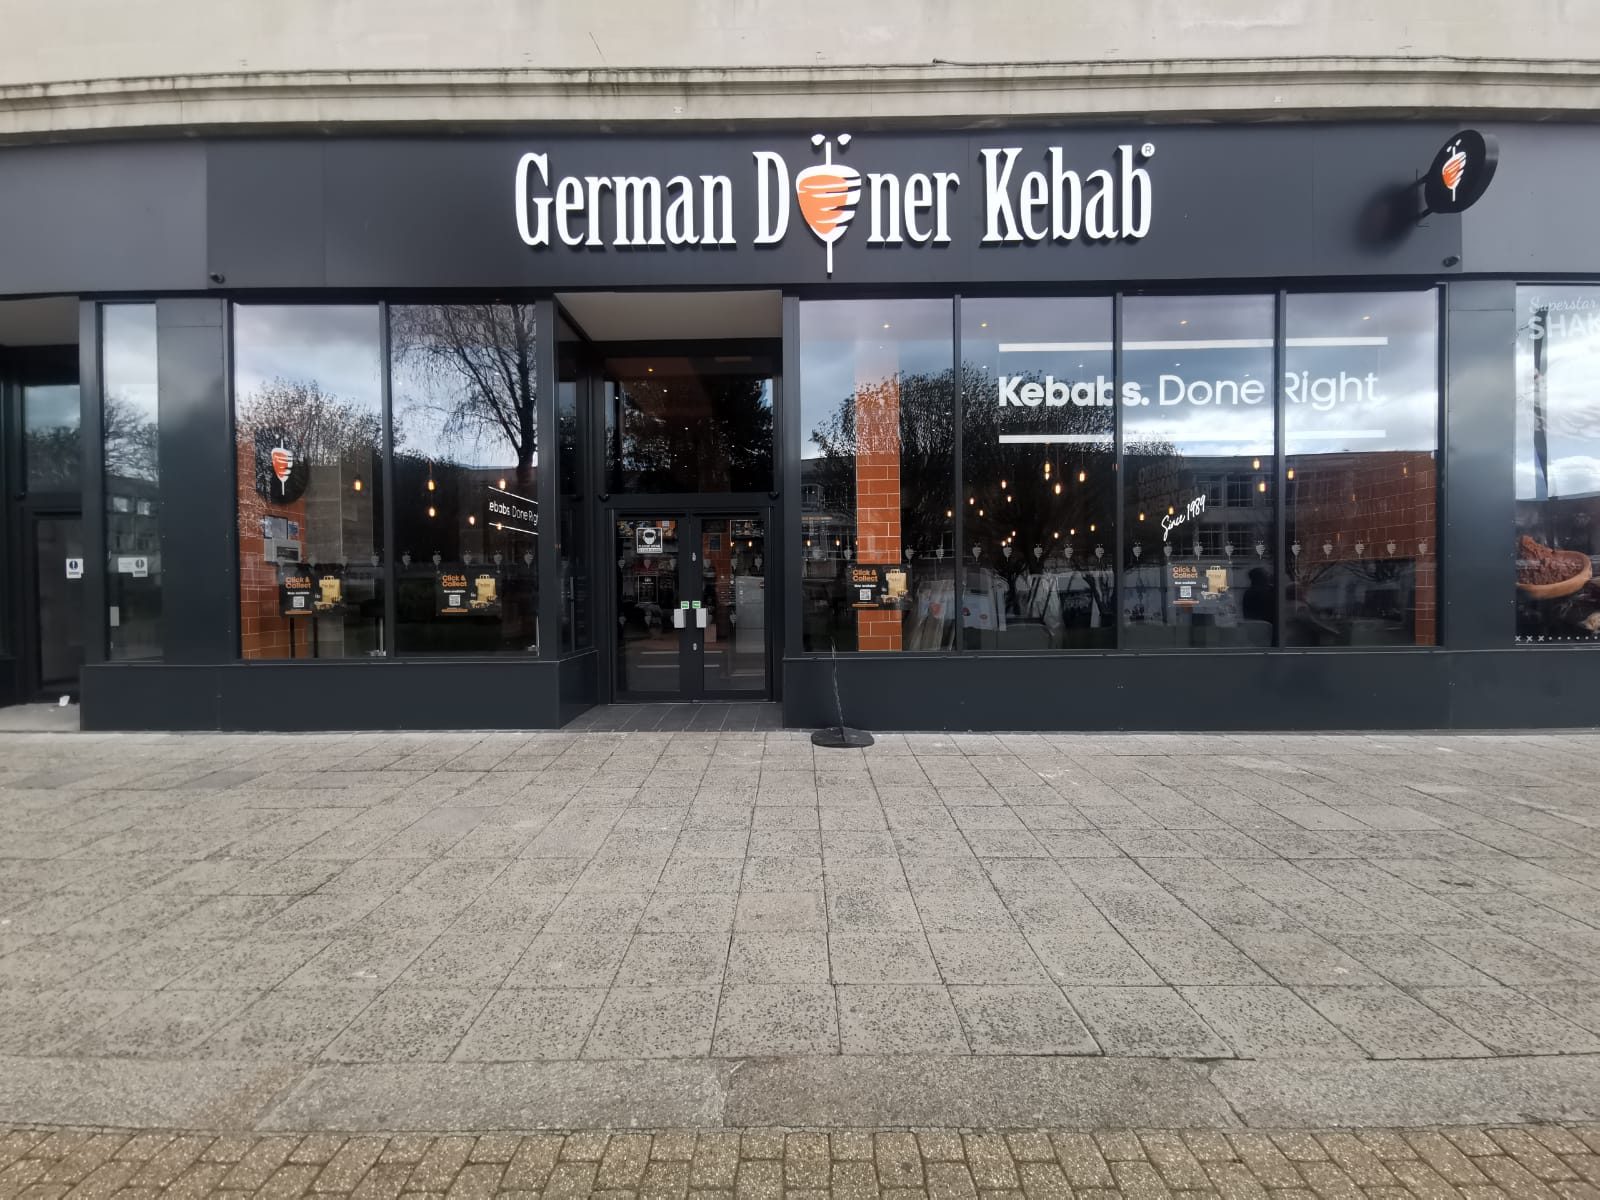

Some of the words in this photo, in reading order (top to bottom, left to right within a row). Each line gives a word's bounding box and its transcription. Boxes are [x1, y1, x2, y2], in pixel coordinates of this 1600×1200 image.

[515, 152, 737, 246] German
[1159, 374, 1266, 406] Done
[1161, 514, 1186, 542] Since
[1186, 494, 1206, 521] 1989
